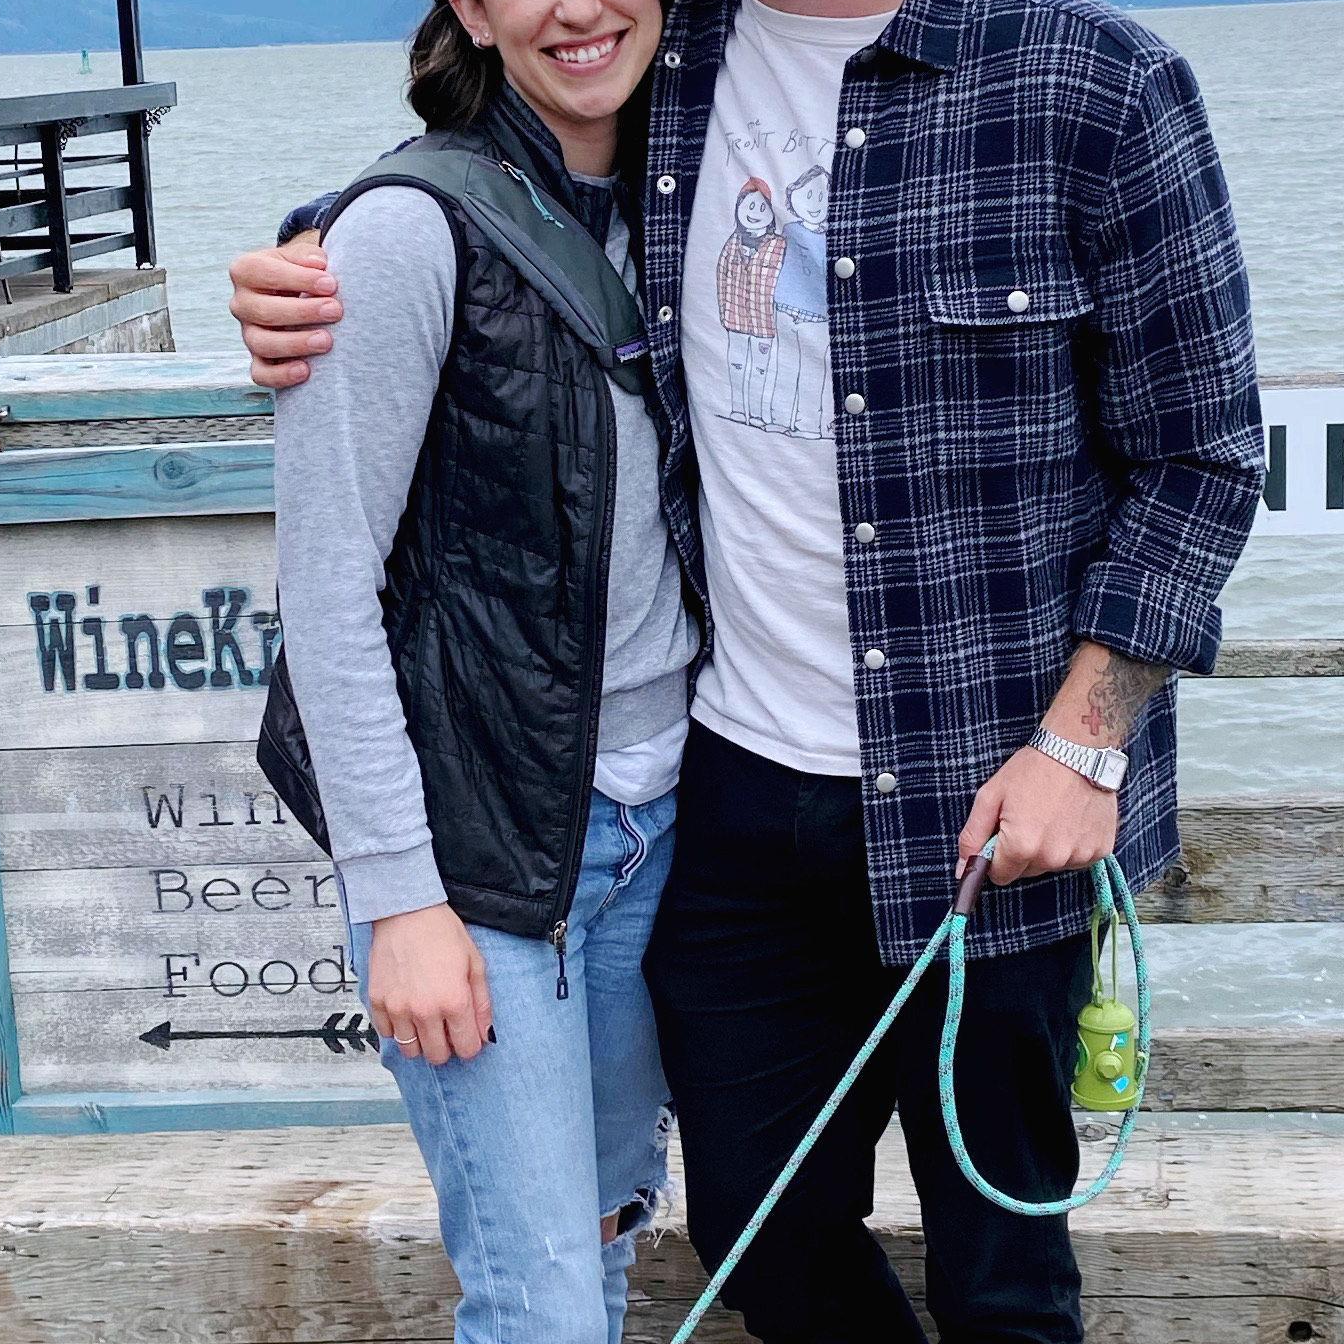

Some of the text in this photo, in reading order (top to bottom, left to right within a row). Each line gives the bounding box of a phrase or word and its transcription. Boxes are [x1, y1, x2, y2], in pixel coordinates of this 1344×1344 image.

[141, 782, 287, 829] Win
[149, 868, 338, 913] Beer
[159, 944, 354, 998] Food
